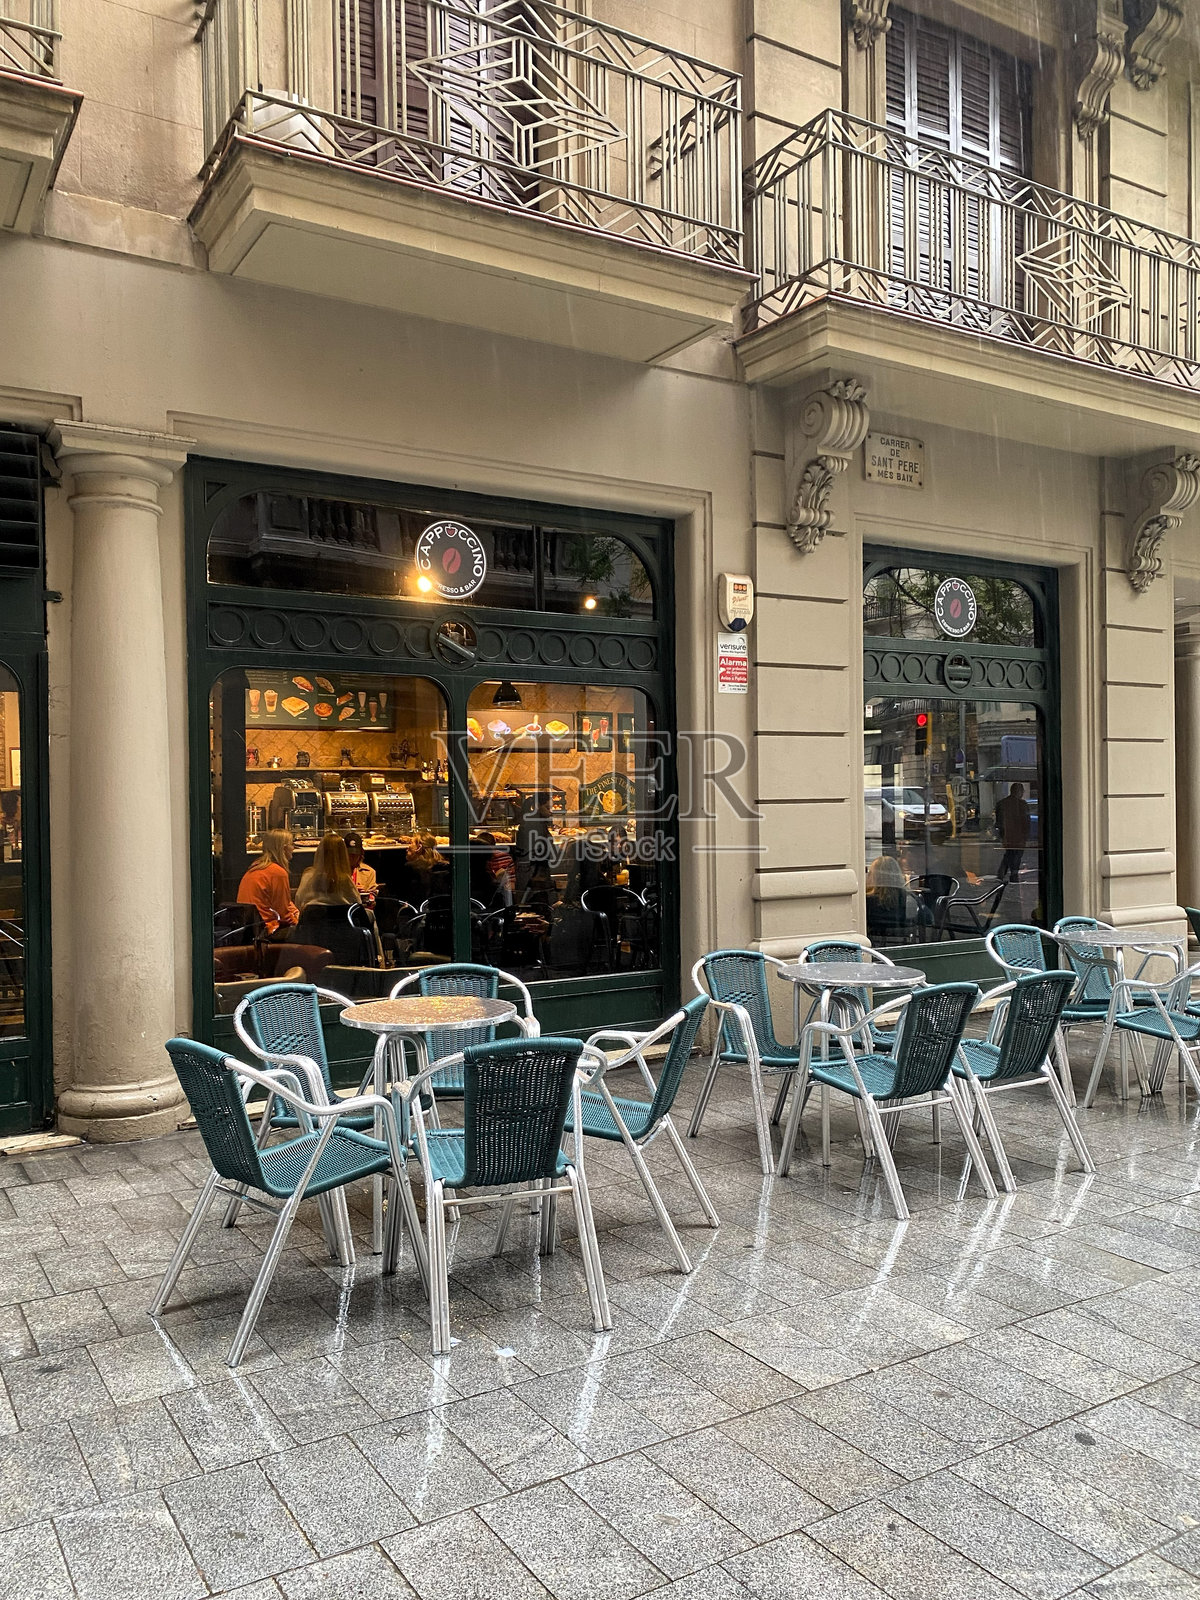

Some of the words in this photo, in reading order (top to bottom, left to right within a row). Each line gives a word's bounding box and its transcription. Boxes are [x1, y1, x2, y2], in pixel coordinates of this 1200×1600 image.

[880, 437, 910, 449] CARRER
[890, 449, 900, 457] DE
[872, 456, 893, 469] SANT
[898, 460, 919, 473] PERE
[896, 473, 913, 483] BAIX
[465, 580, 476, 590] BAR
[720, 658, 746, 667] Alarma
[586, 786, 598, 796] THE
